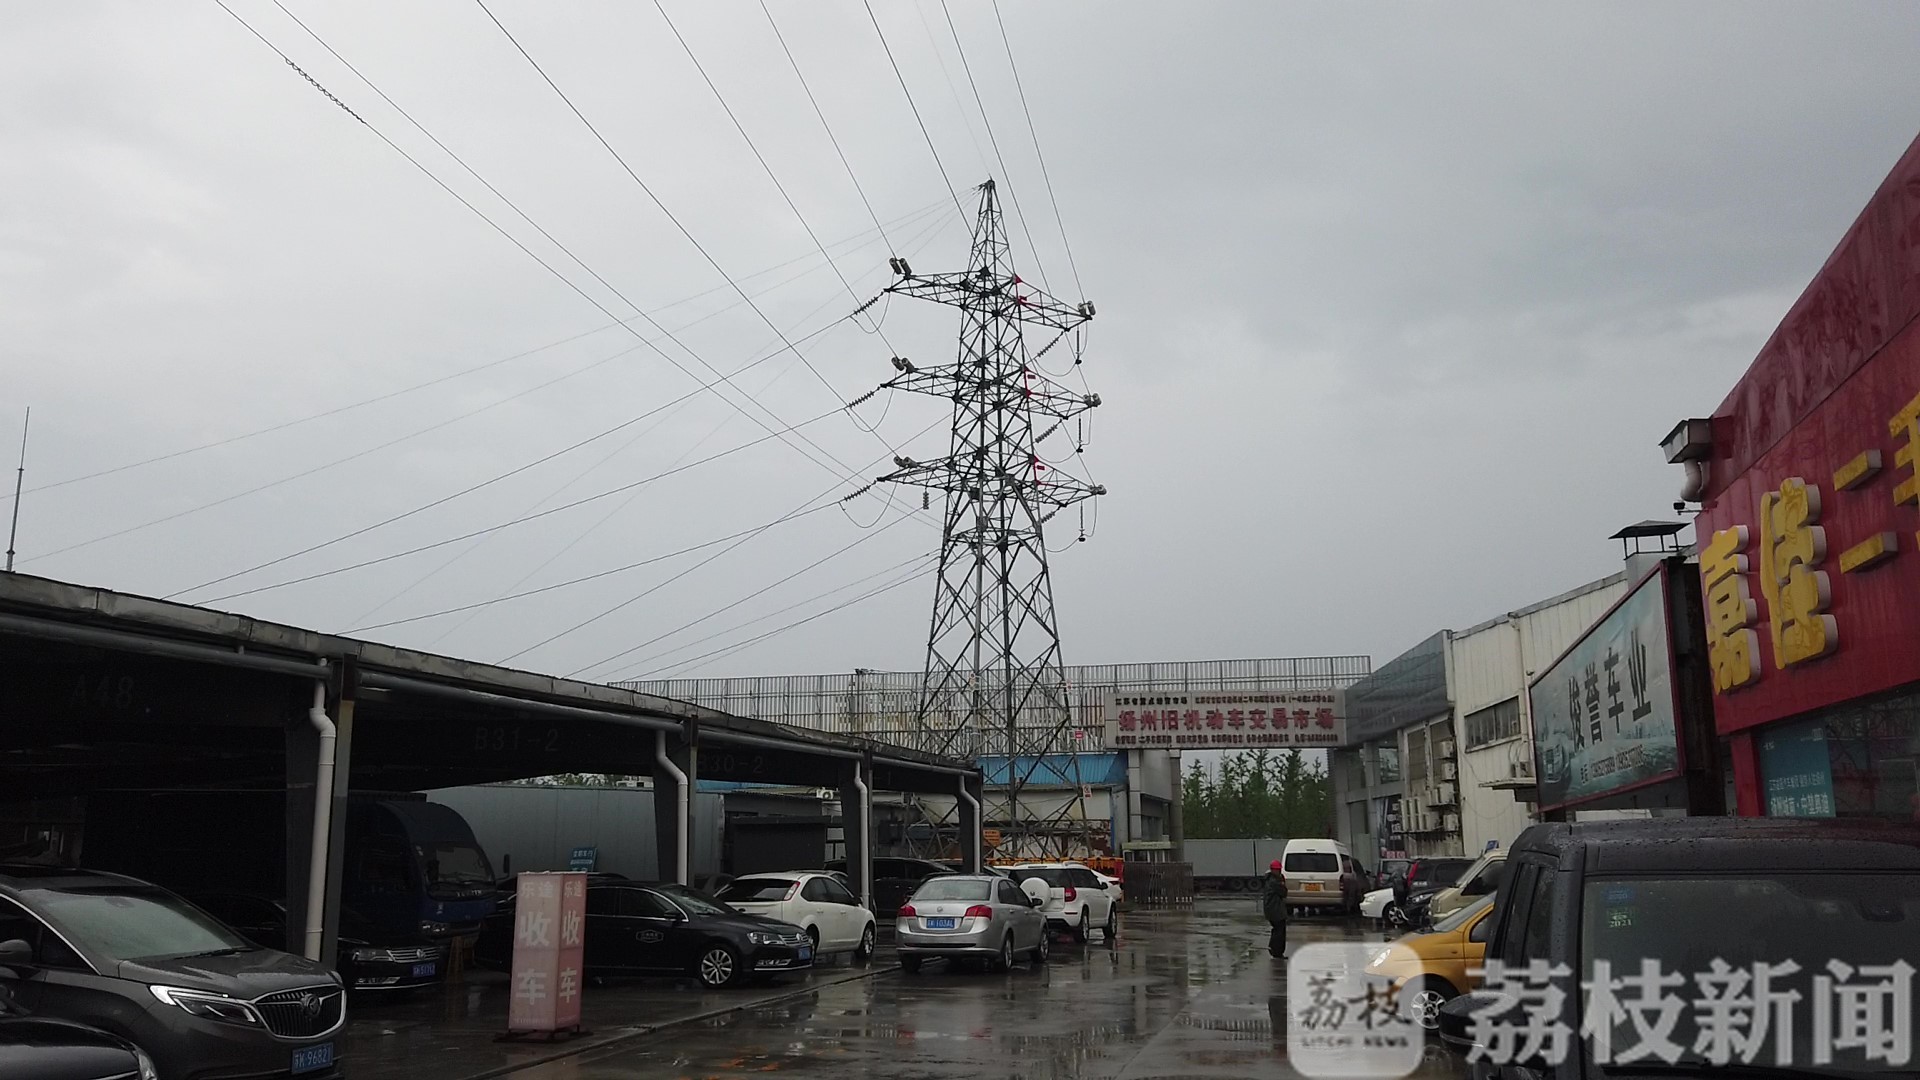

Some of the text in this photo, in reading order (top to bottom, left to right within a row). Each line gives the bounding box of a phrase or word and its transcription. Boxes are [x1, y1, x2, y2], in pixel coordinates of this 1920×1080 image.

[1119, 707, 1335, 732] 扬州旧机动车交易市场
[473, 725, 560, 753] B31-2
